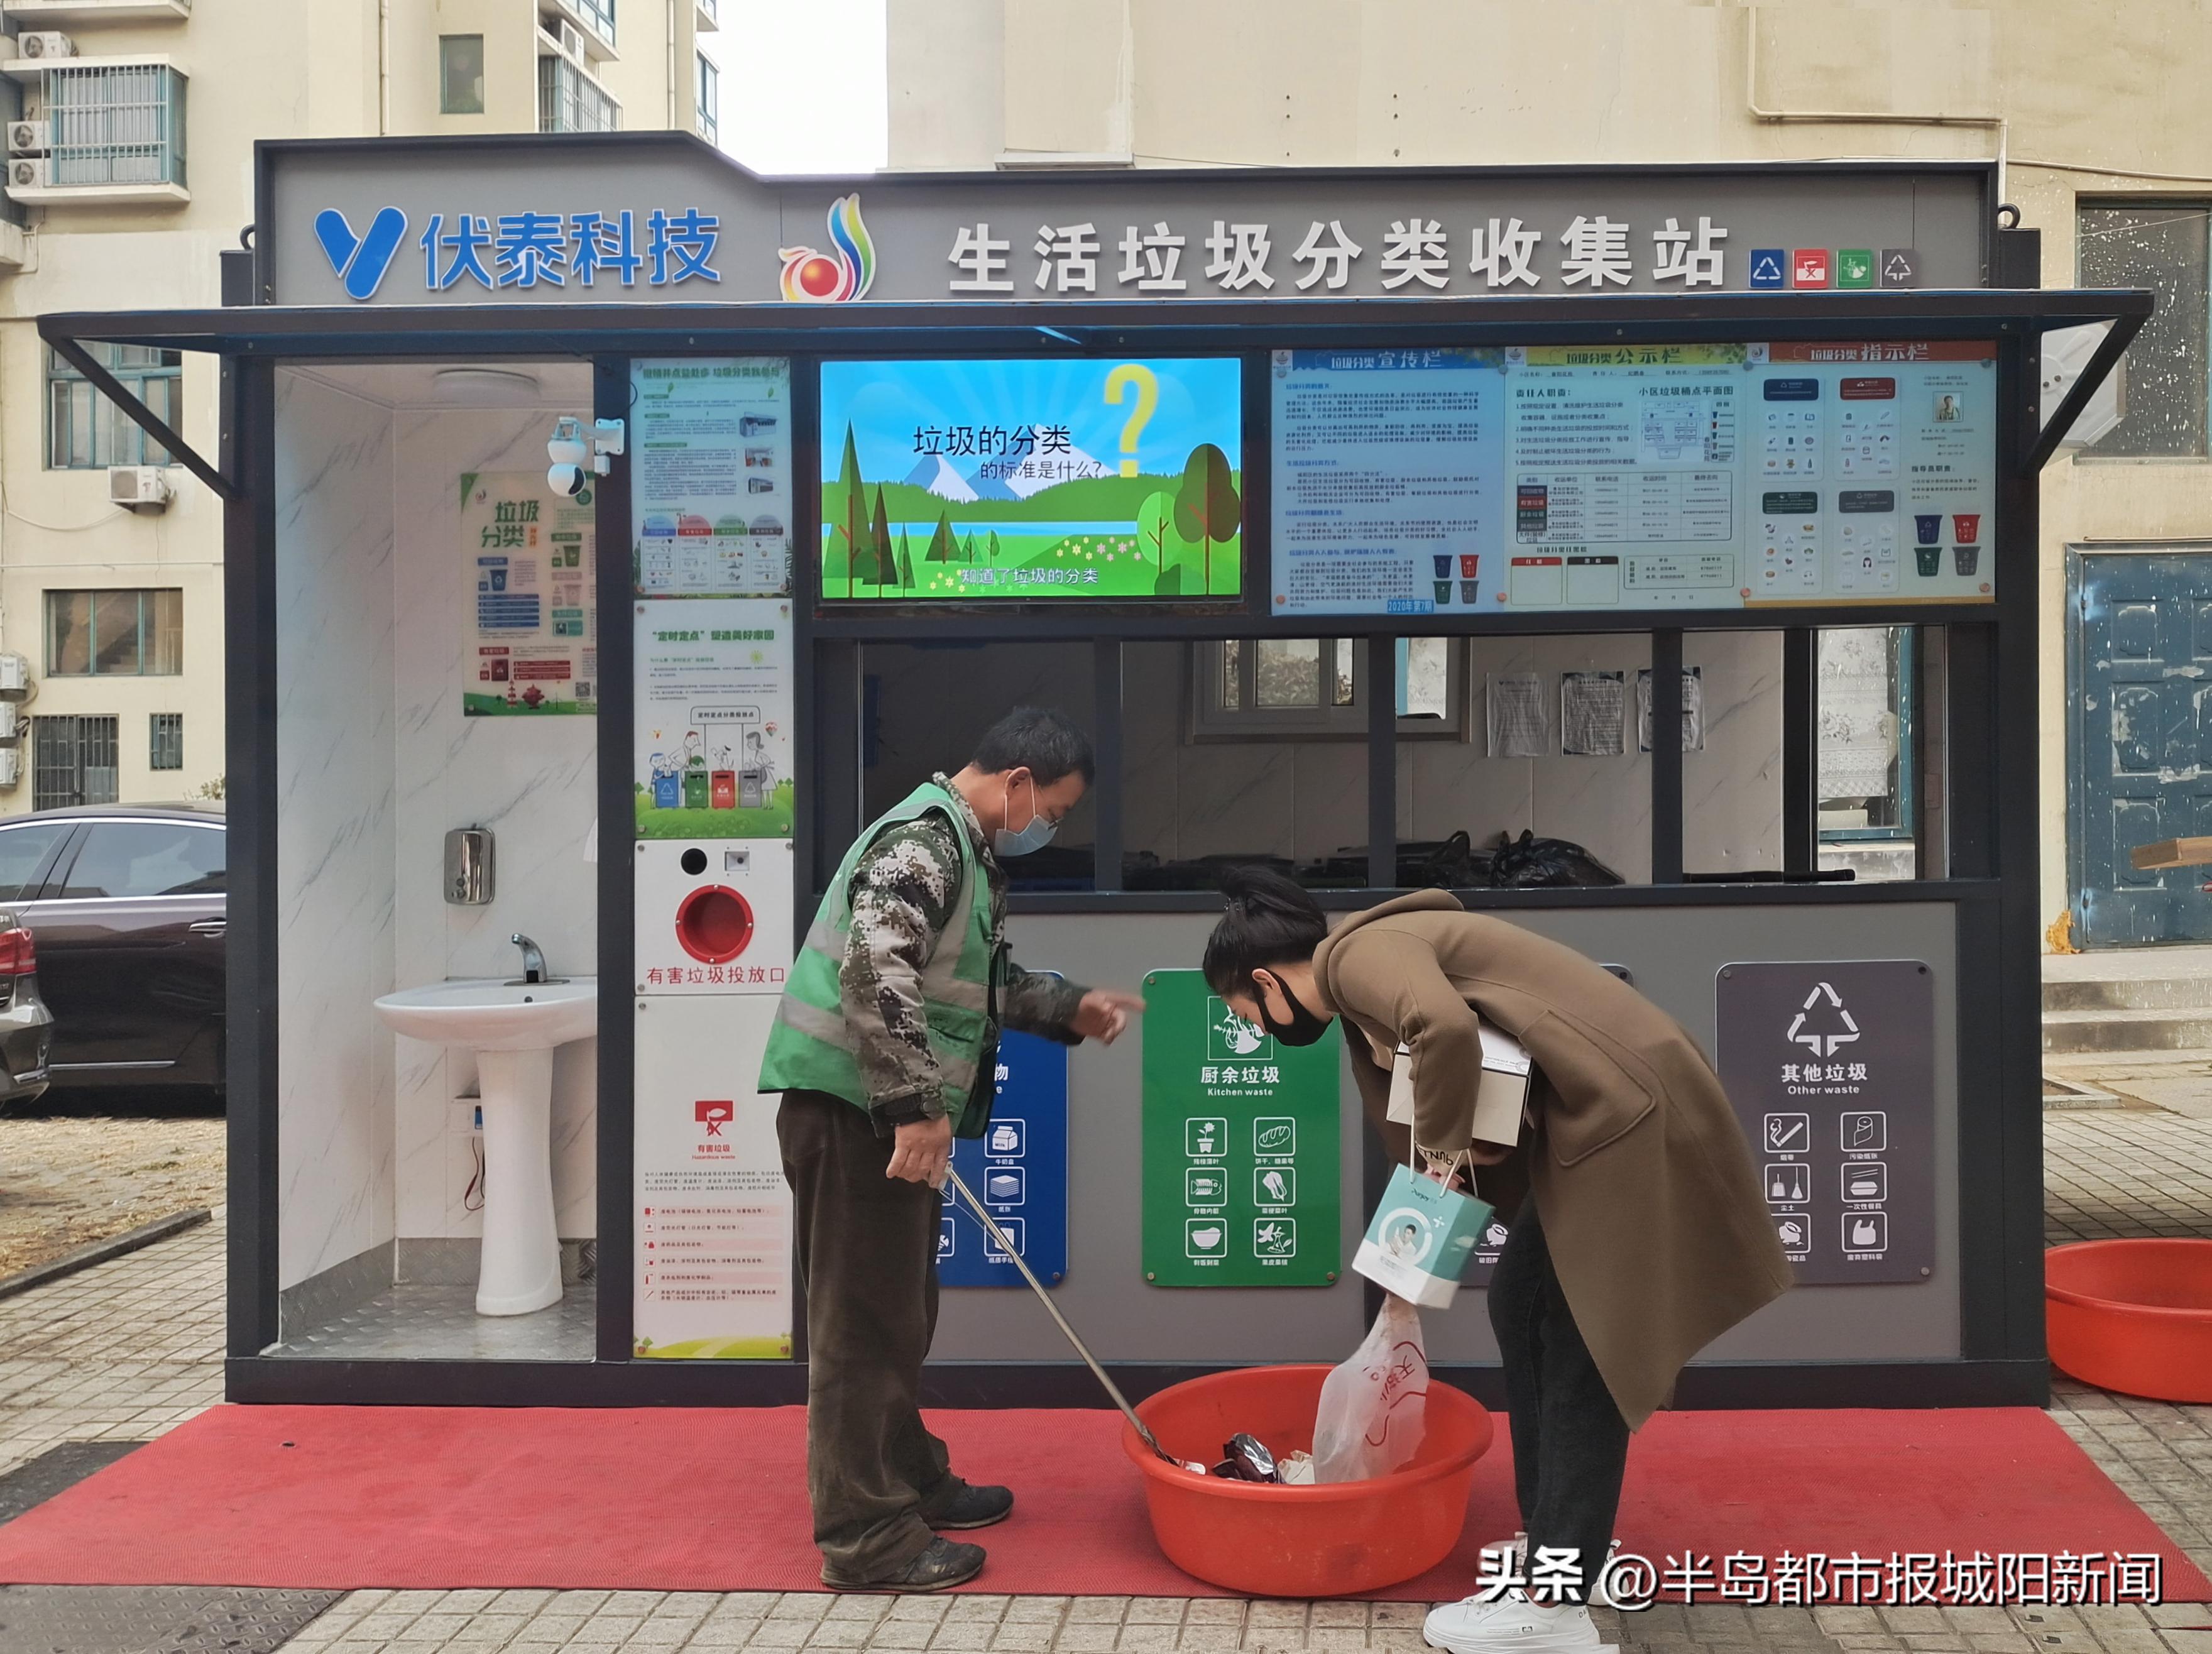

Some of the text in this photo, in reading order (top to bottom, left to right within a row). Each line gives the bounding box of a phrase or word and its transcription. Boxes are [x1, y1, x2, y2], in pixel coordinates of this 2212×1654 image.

[419, 207, 721, 290] 伏泰科技
[948, 216, 1728, 292] 生活垃圾分类收集站
[1639, 386, 1733, 396] 小区垃圾桶点平面图
[913, 424, 1071, 456] 垃圾的分类
[495, 500, 539, 523] 垃圾
[481, 525, 525, 548] 分类
[961, 568, 1099, 584] 知道了垃圾的分类
[647, 966, 784, 984] 有害垃圾投放口
[1201, 1066, 1280, 1084] 厨余垃圾
[1781, 1063, 1868, 1082] 其他垃圾
[1207, 1088, 1242, 1096] Kitchen
[1788, 1085, 1860, 1095] Other waste
[698, 1144, 730, 1153] 有害垃圾
